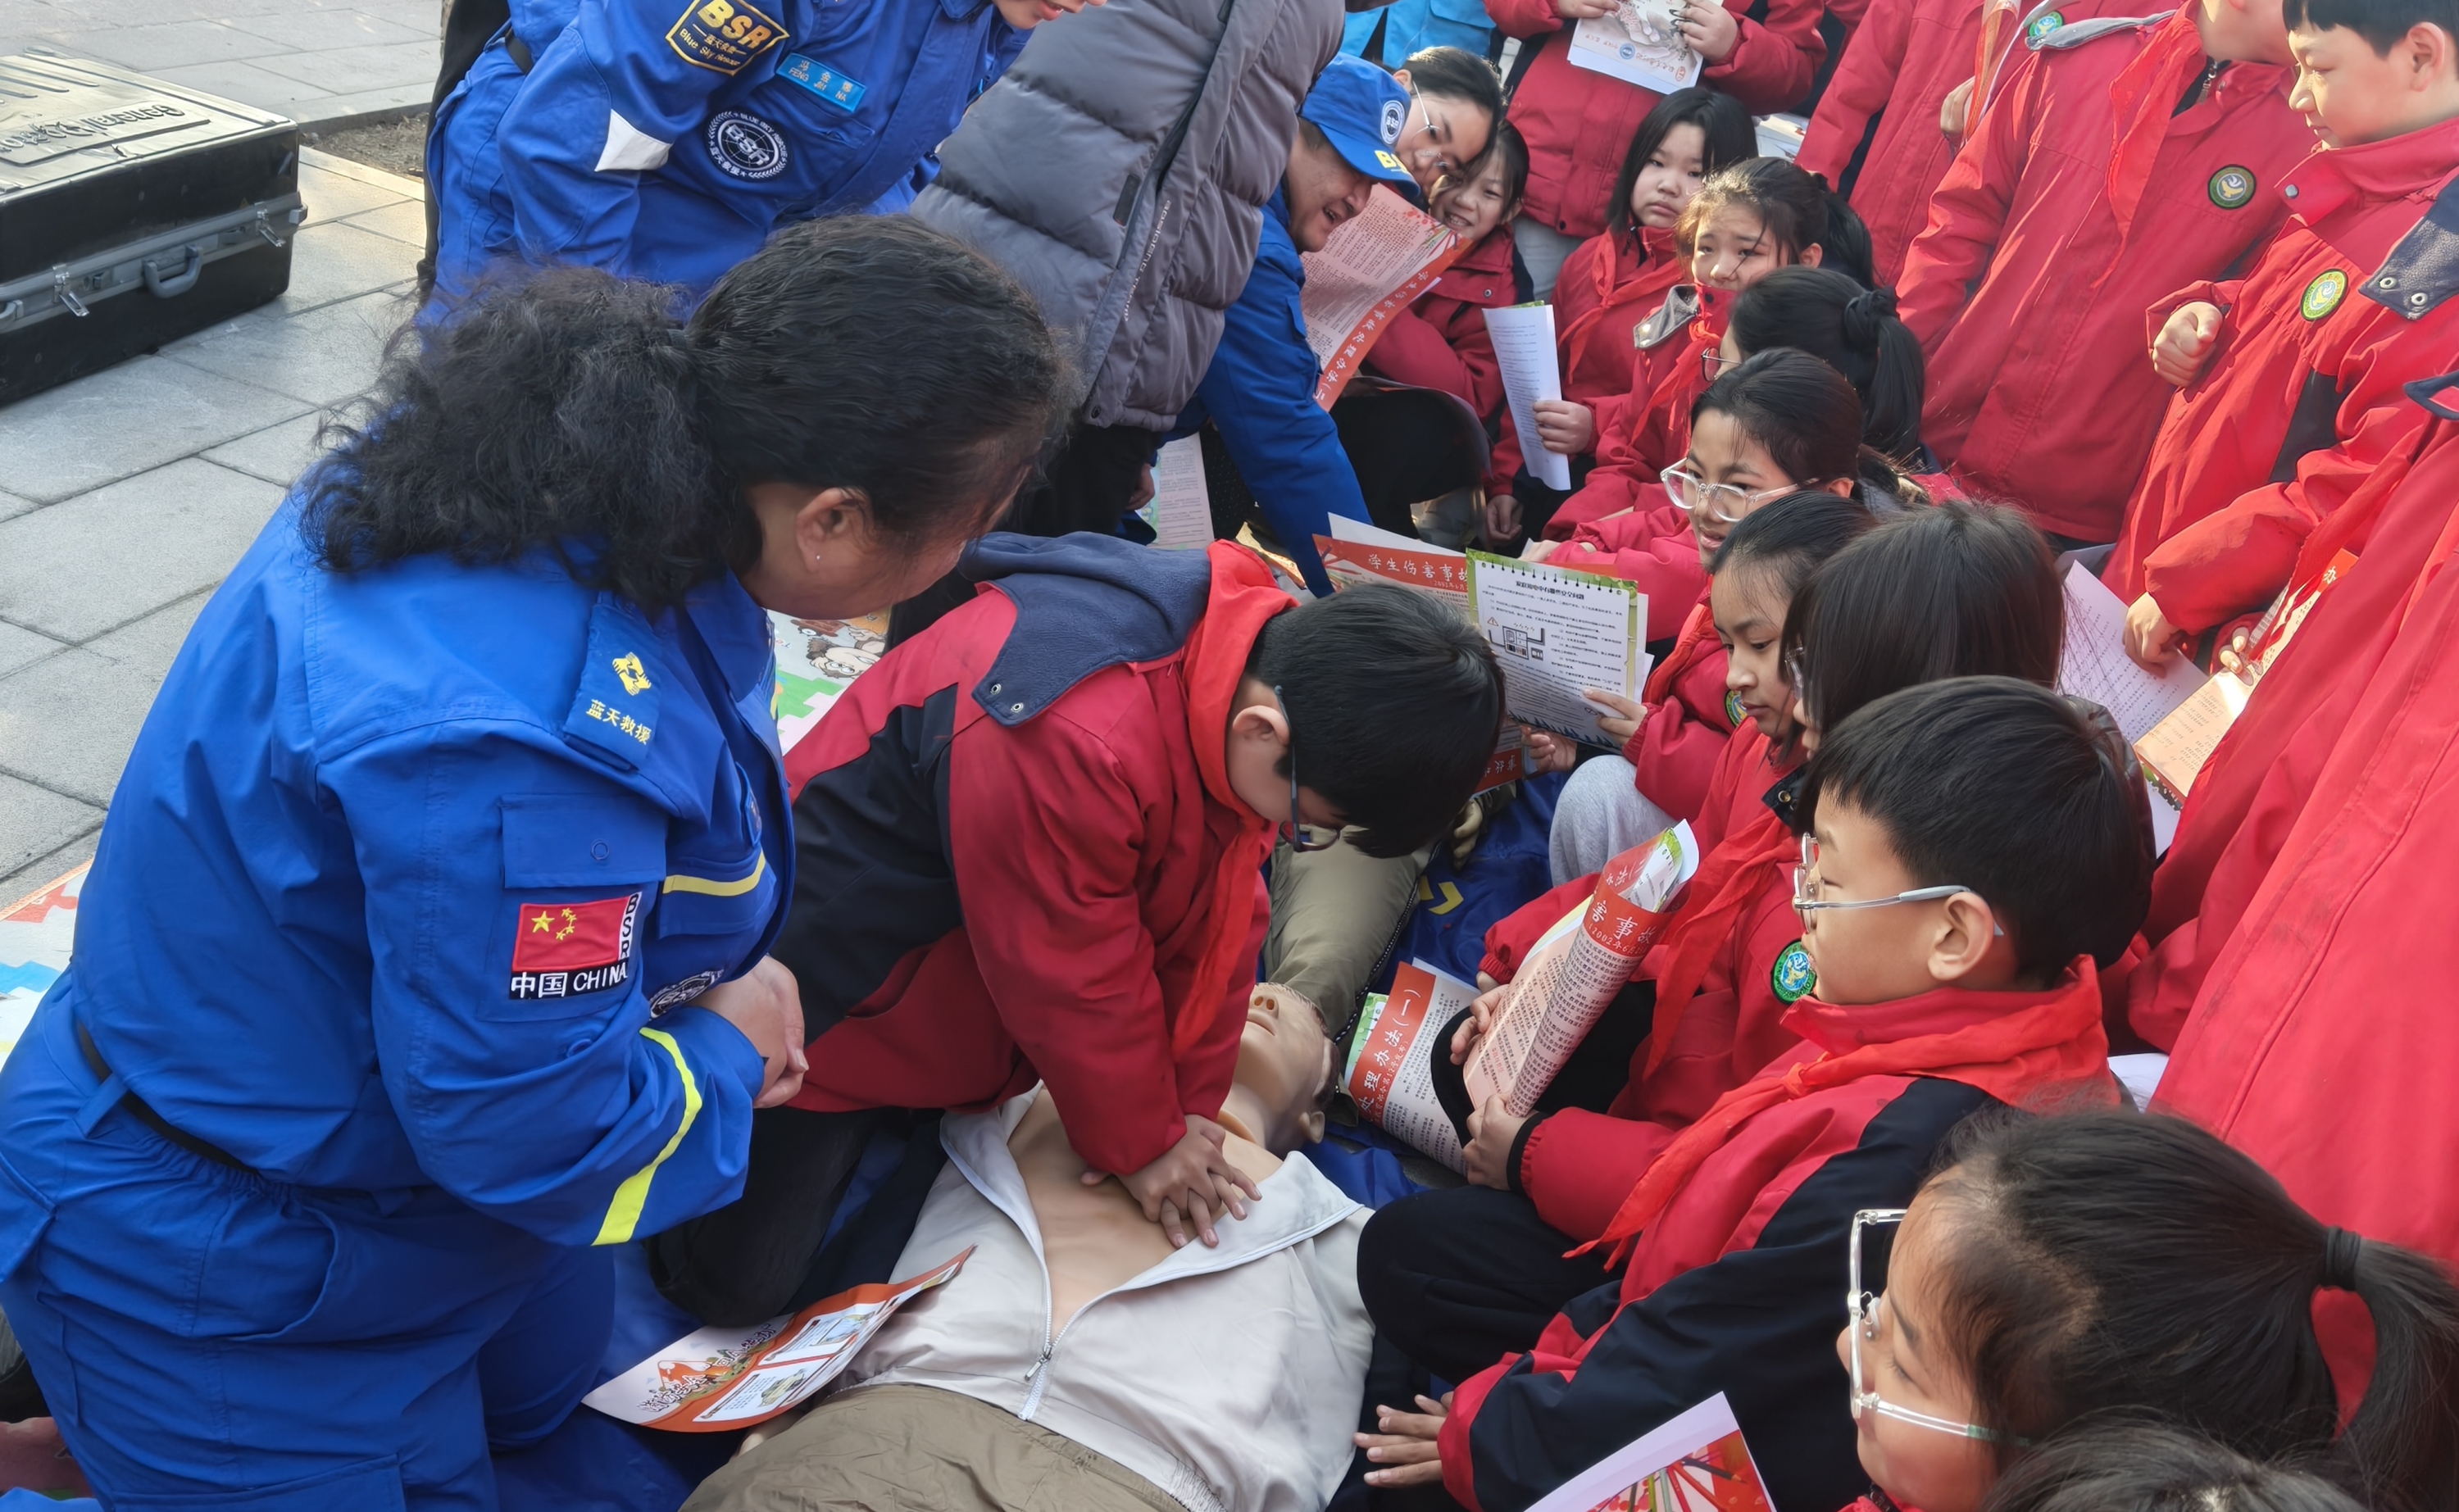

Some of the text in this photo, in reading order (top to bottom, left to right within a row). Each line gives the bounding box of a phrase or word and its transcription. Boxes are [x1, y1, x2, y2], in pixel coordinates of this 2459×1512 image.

[698, 0, 772, 49] BSR
[679, 28, 699, 49] Blue
[699, 46, 716, 59] Sky
[80, 104, 185, 129] General
[725, 124, 770, 166] BSR
[585, 698, 652, 745] 蓝天救援
[620, 893, 639, 959] BSR
[511, 971, 567, 999] 中国
[573, 962, 629, 992] CHINA
